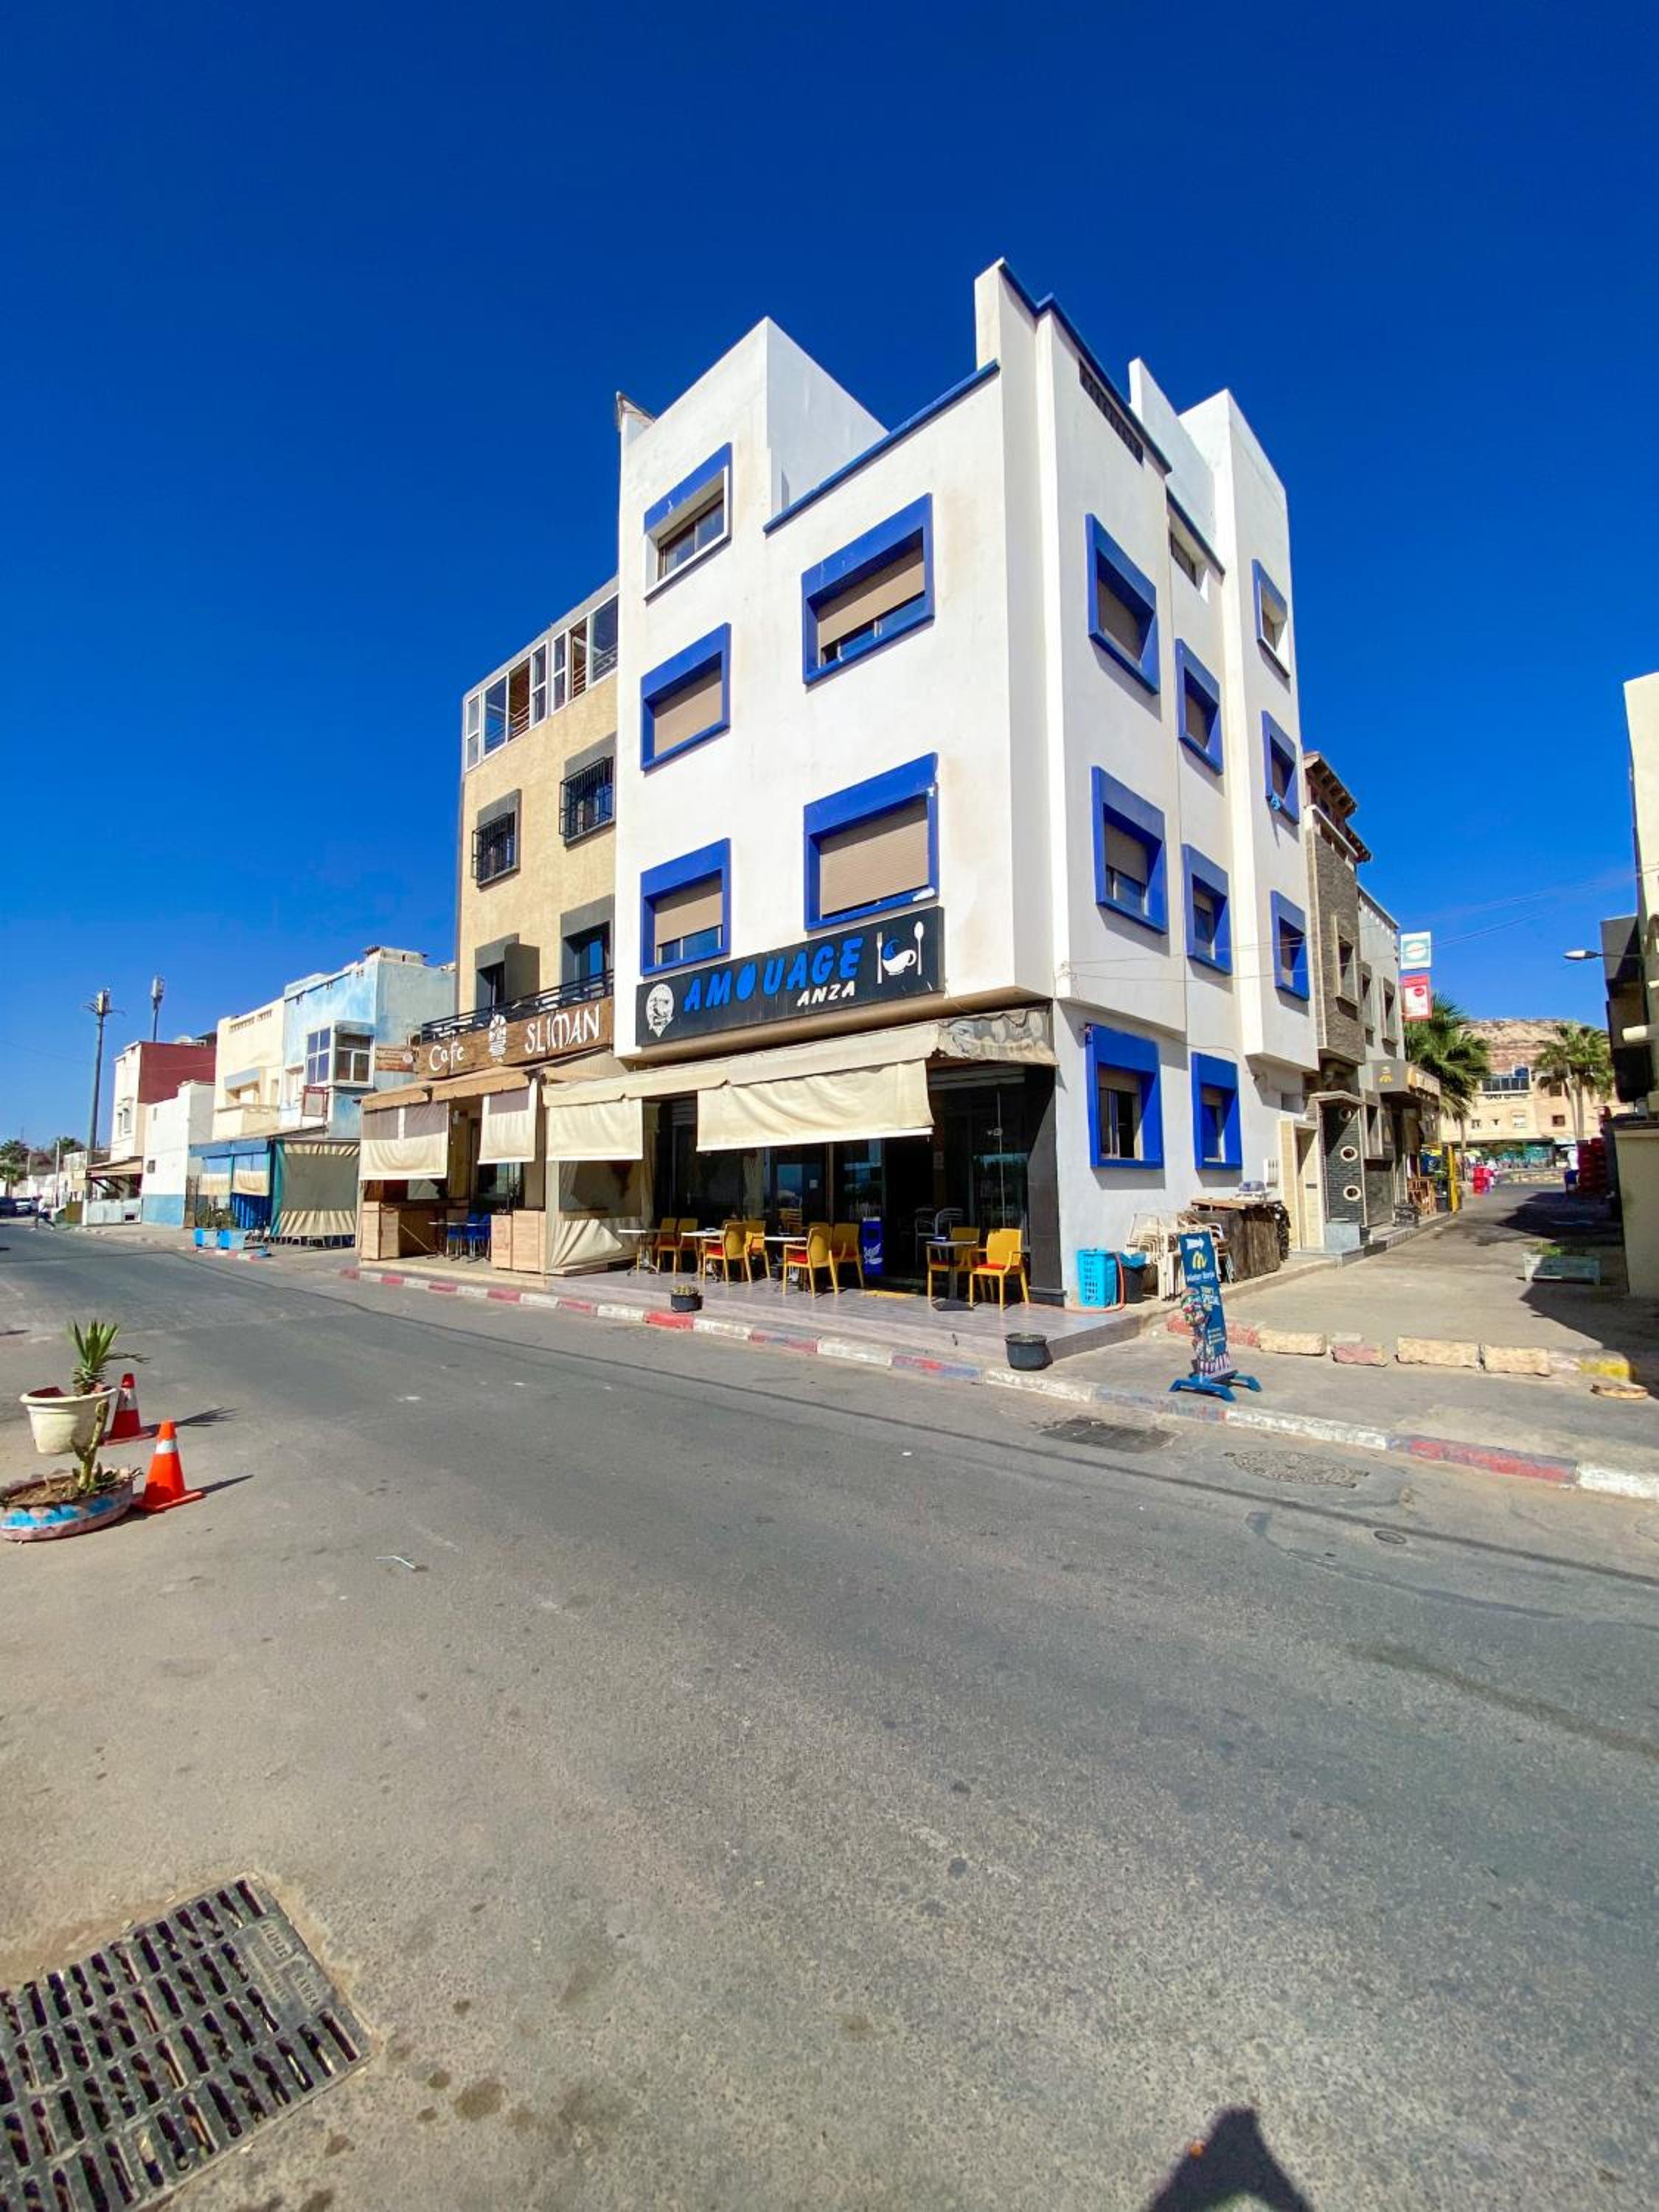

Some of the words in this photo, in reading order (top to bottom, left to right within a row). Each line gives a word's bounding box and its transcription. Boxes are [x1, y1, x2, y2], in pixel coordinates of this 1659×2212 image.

[684, 936, 863, 1012] AMOUAGE
[796, 980, 855, 1007] ANZA
[524, 1004, 600, 1055] SLIMAN
